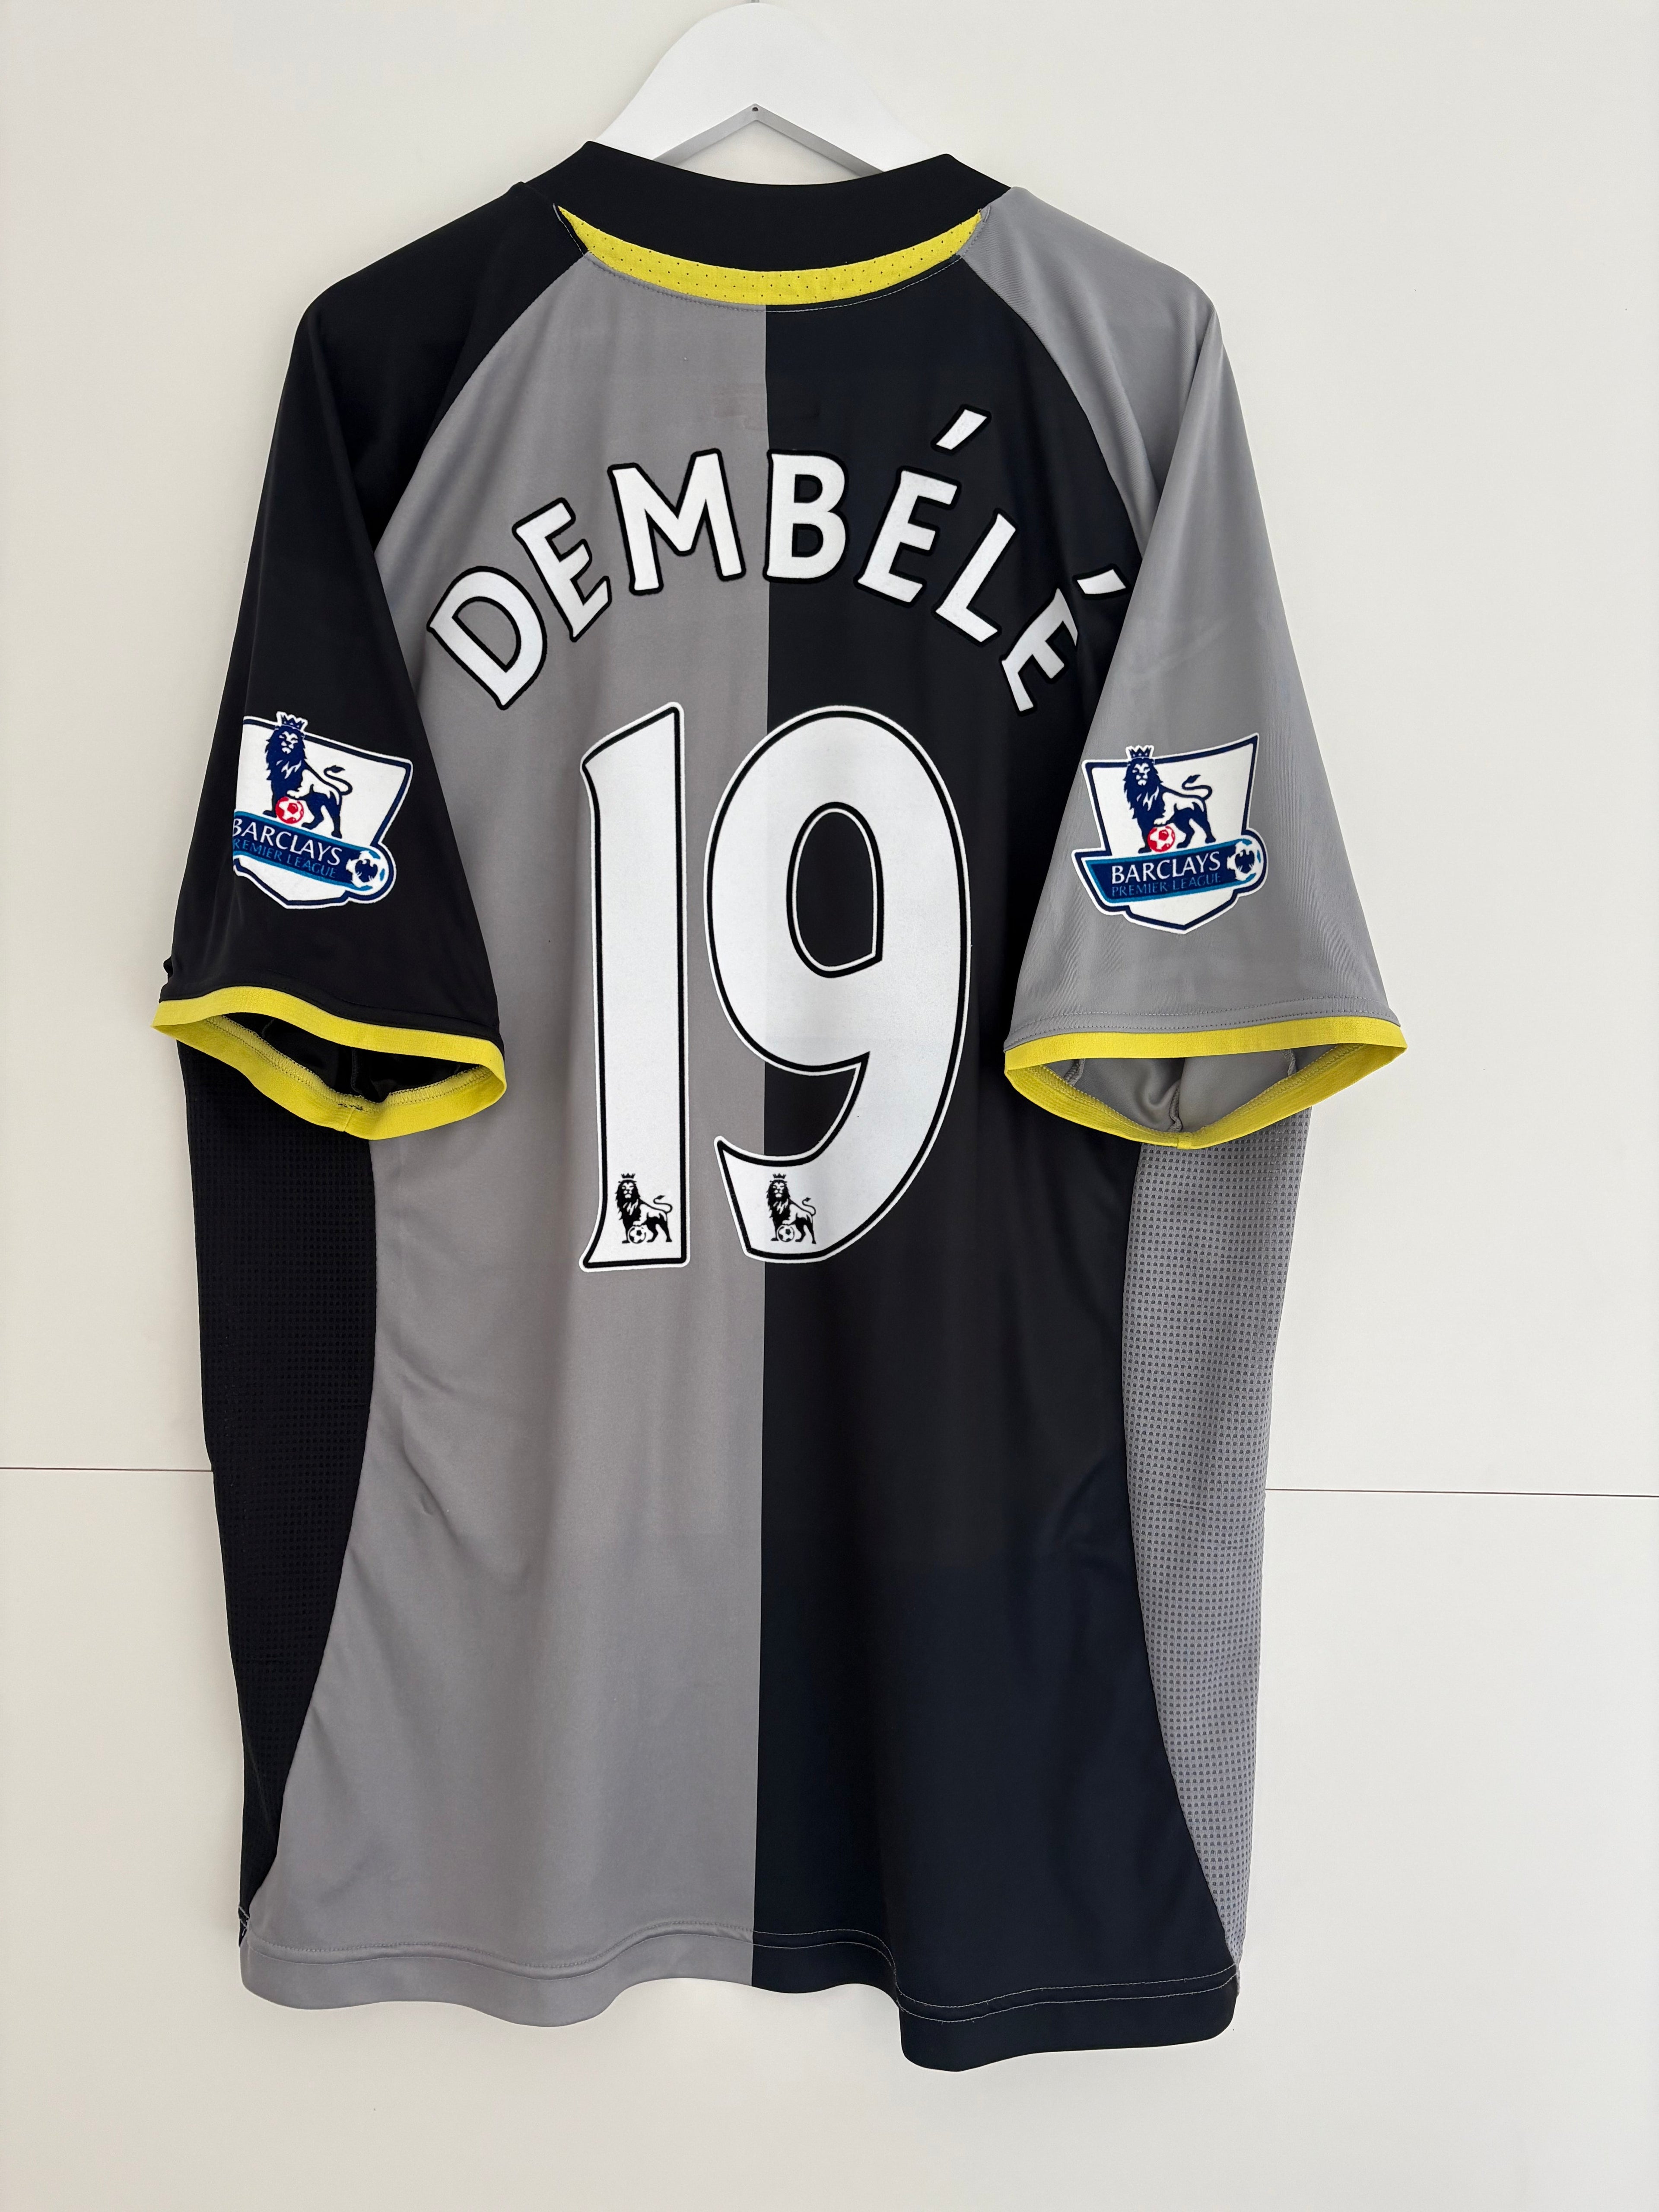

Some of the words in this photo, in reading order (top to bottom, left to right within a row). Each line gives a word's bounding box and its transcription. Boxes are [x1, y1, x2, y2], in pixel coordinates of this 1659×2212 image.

[427, 407, 1130, 717] DEMBÉLÉ
[232, 818, 342, 866] BARCLAYS
[233, 838, 282, 861] REMIER
[286, 854, 336, 878] LEAGUE
[1112, 851, 1221, 884] BARCLAYS
[1112, 882, 1167, 897] PREMIER
[1173, 872, 1221, 890] LEAGUE
[580, 701, 971, 1272] 19
